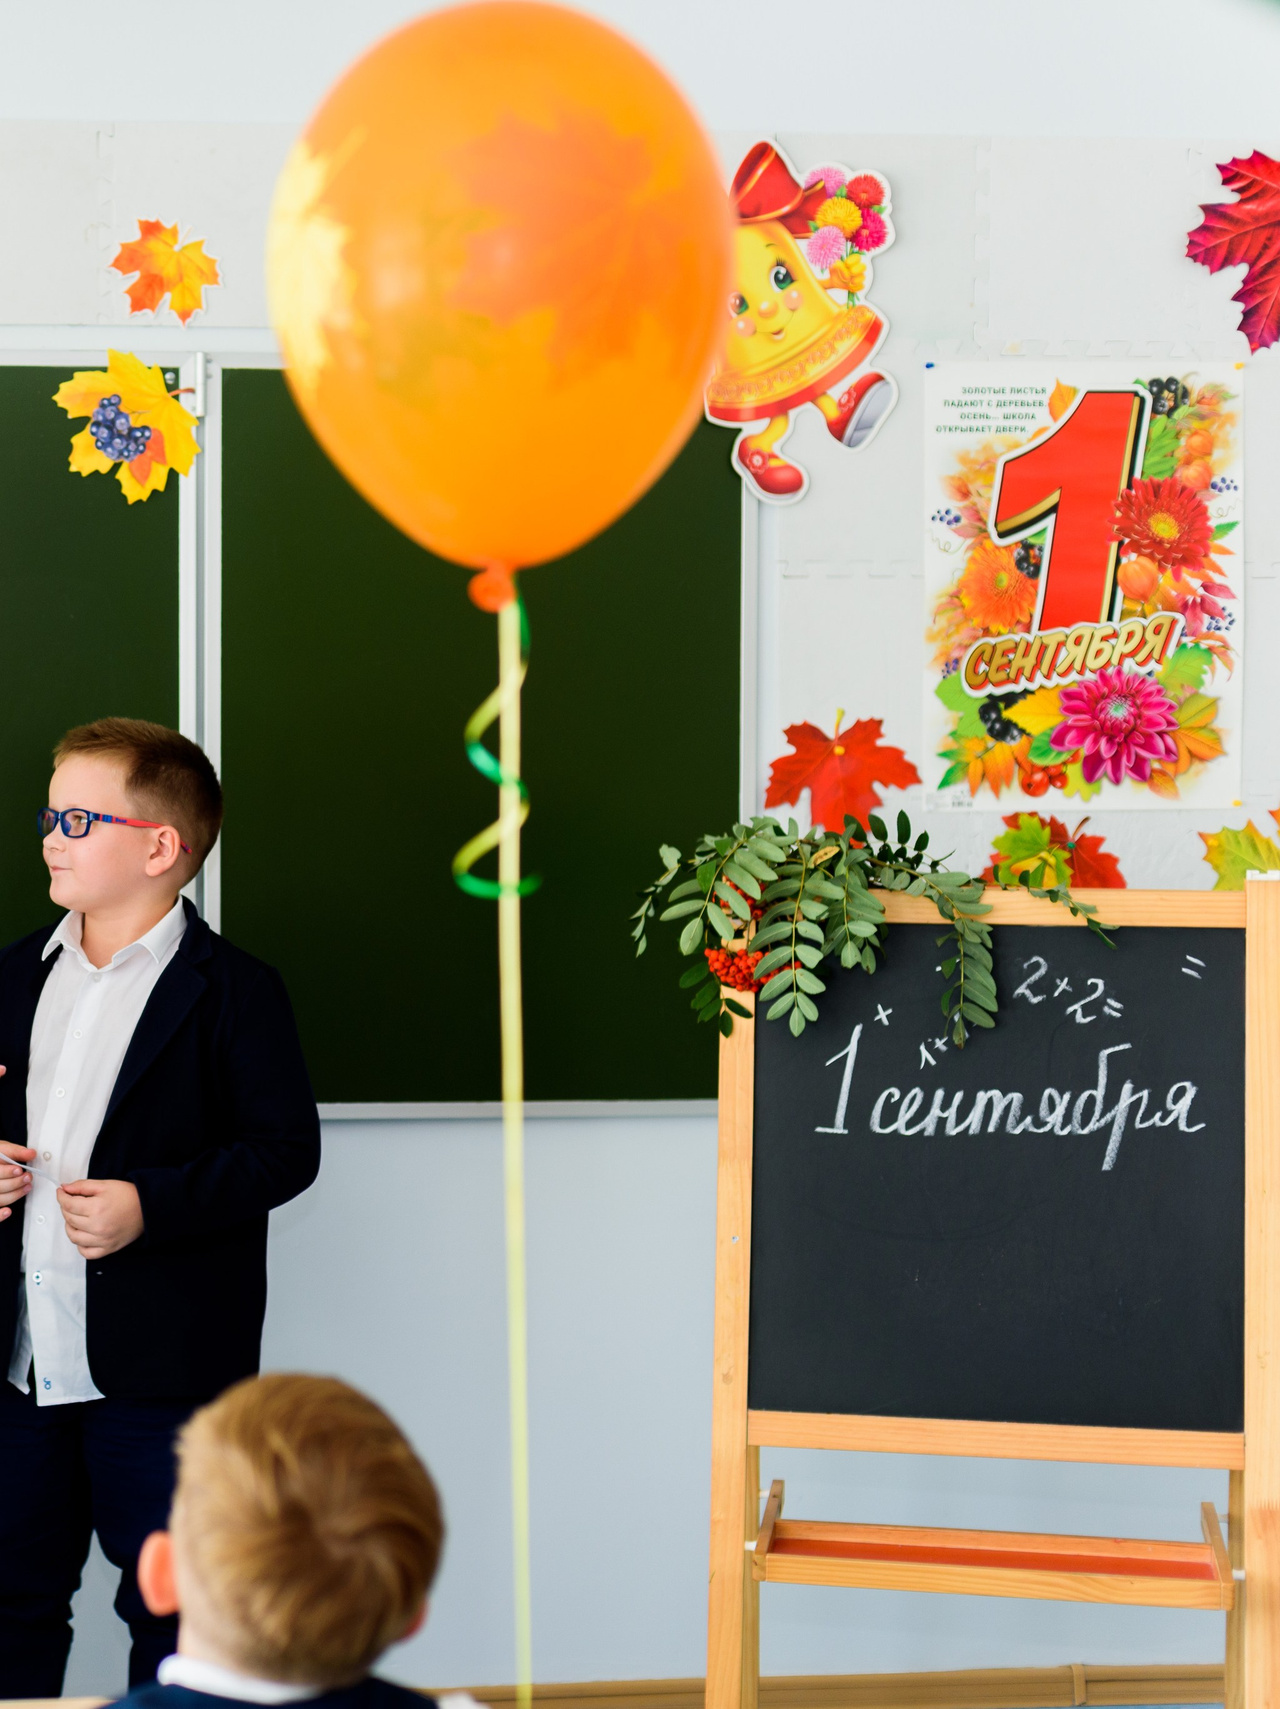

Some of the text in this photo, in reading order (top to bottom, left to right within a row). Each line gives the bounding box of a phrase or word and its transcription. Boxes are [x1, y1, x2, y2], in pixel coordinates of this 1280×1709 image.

[961, 386, 1047, 395] ЗОЛОТЫЕ ЛИСТЬЯ
[943, 399, 1047, 408] ПАДАЮТ С ДЕРЕВЬЕВ.
[960, 412, 1037, 421] ОСЕНЬ... ШКОЛА
[936, 425, 1029, 434] ОТКРЫВАЕТ ДВЕРИ.
[995, 389, 1145, 632] 1
[964, 614, 1178, 690] СЕНТЯБРЯ
[815, 1023, 1207, 1172] 1 сентября
